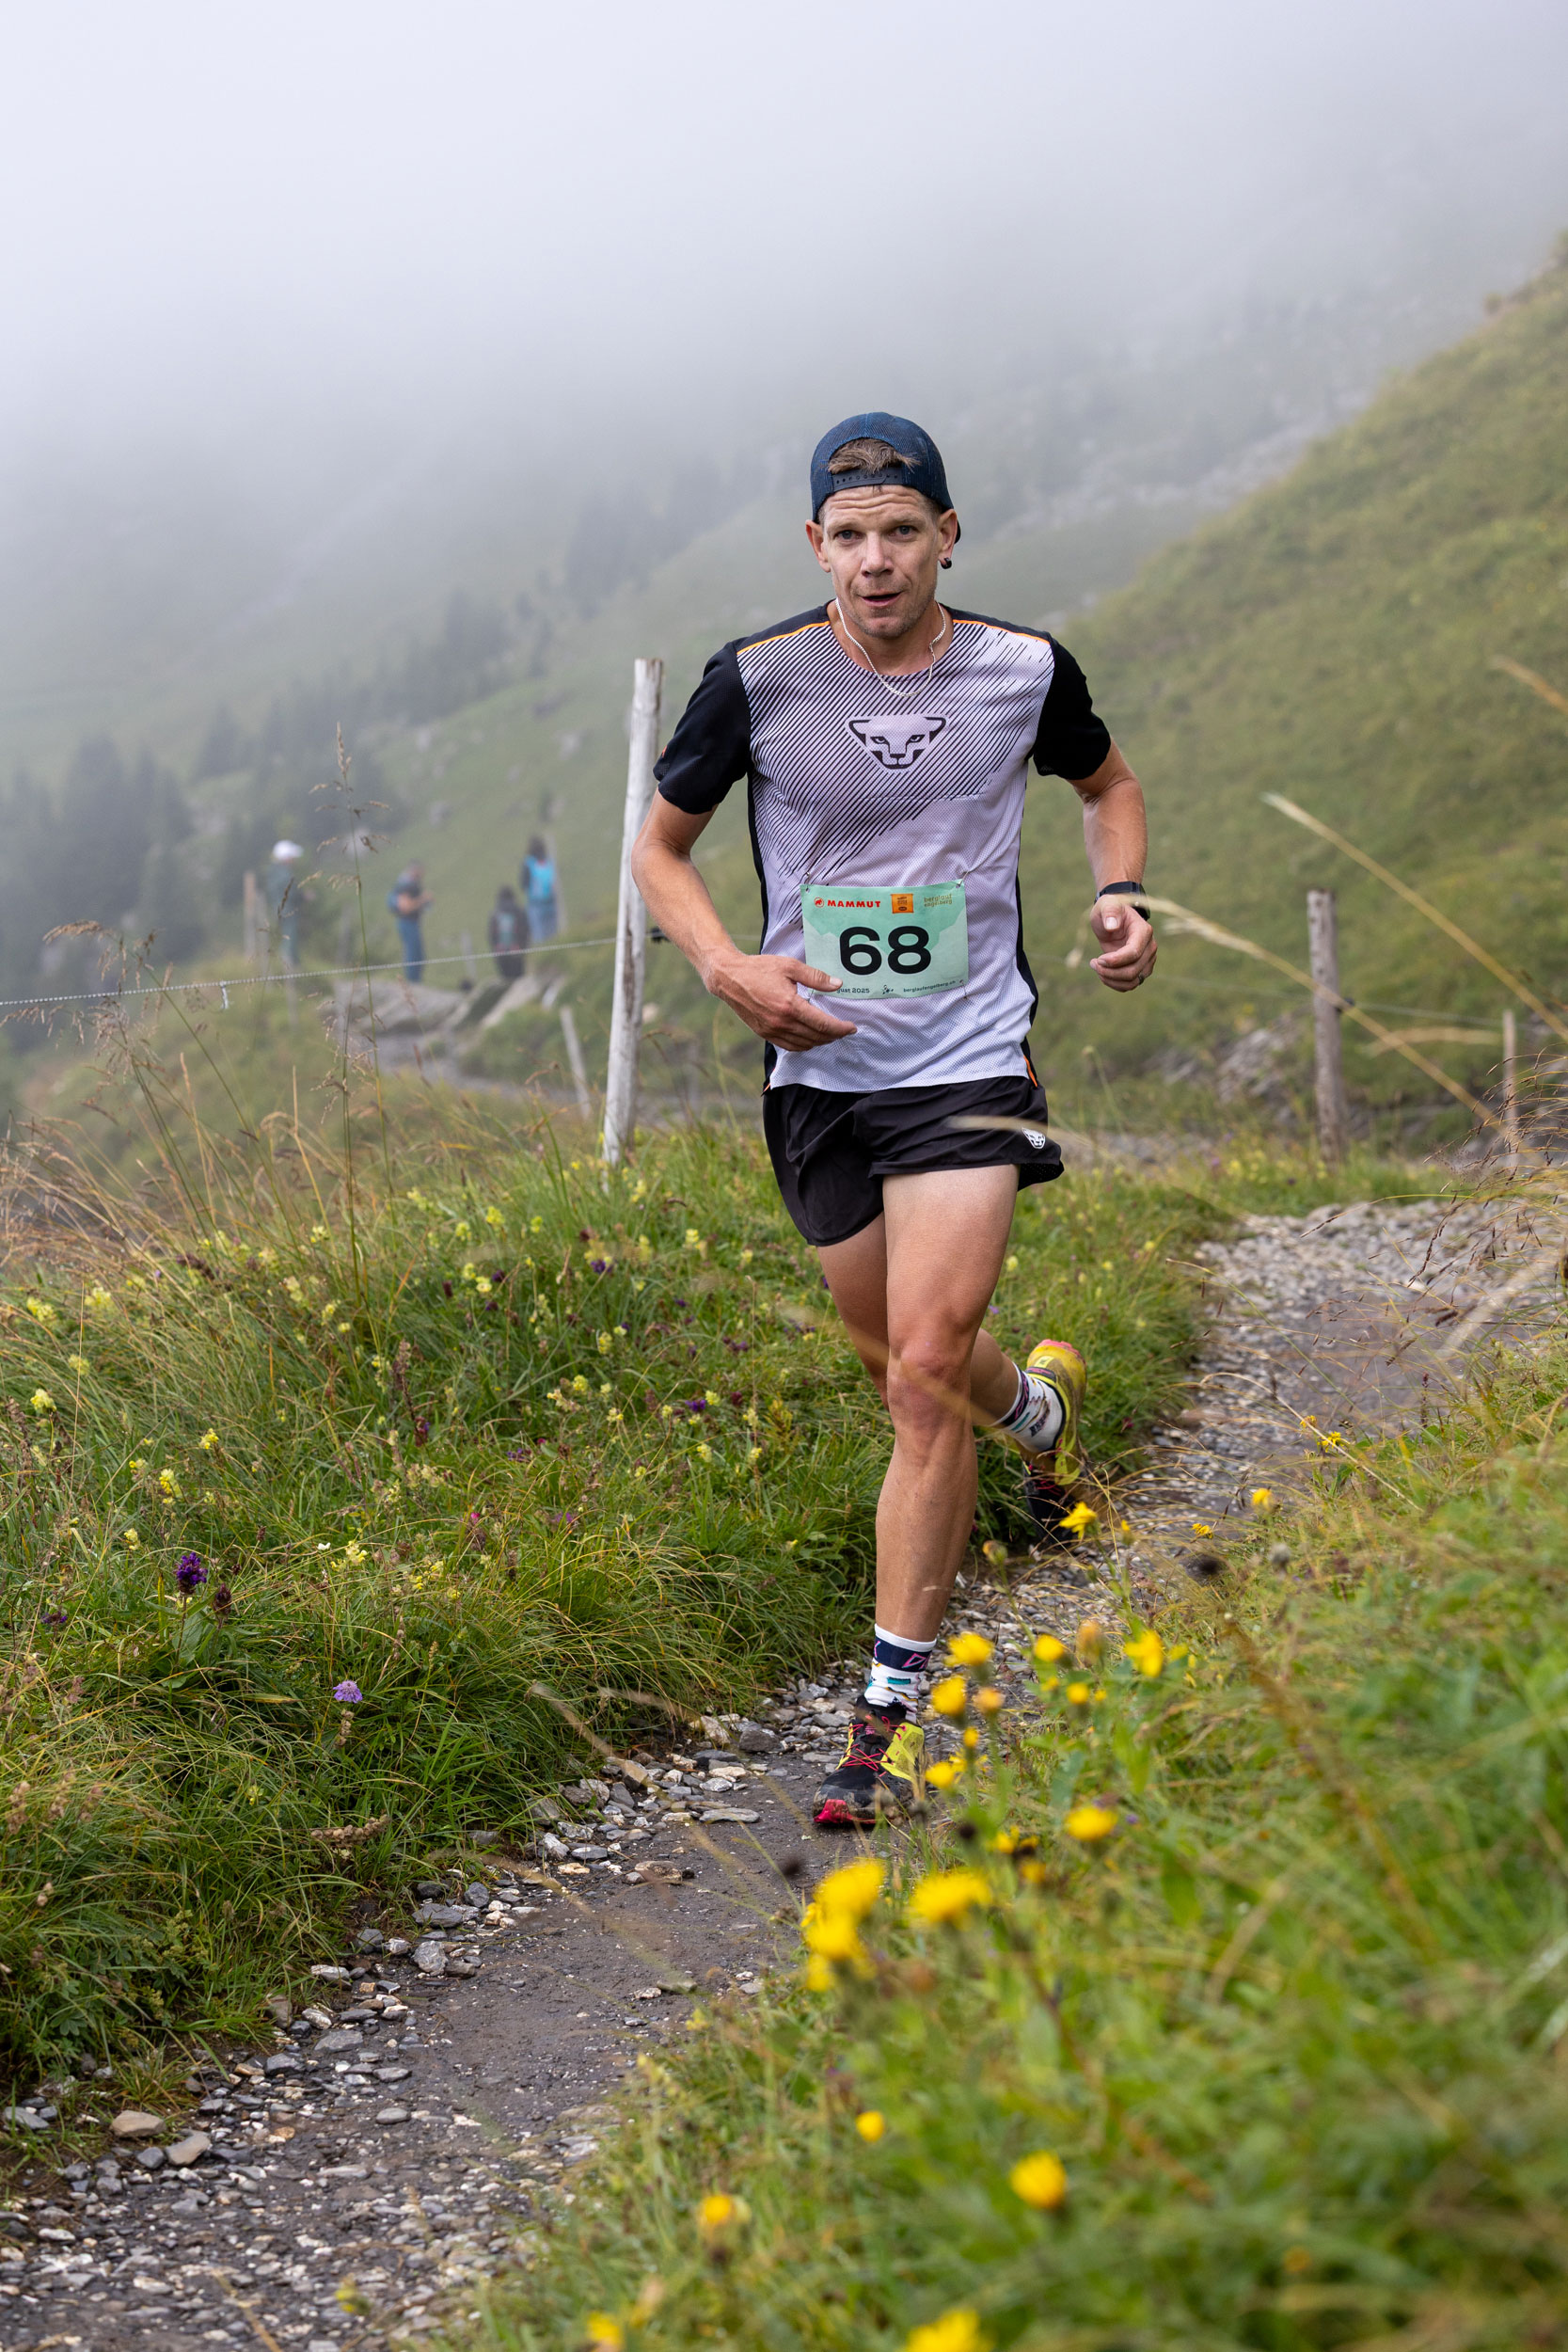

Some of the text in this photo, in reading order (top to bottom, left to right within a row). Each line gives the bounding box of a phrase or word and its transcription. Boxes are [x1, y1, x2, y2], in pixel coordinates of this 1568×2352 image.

[827, 899, 880, 908] MAMMUT
[924, 894, 952, 902] berglauf
[839, 926, 931, 975] 68
[903, 980, 956, 993] berglaufengelberg.ch
